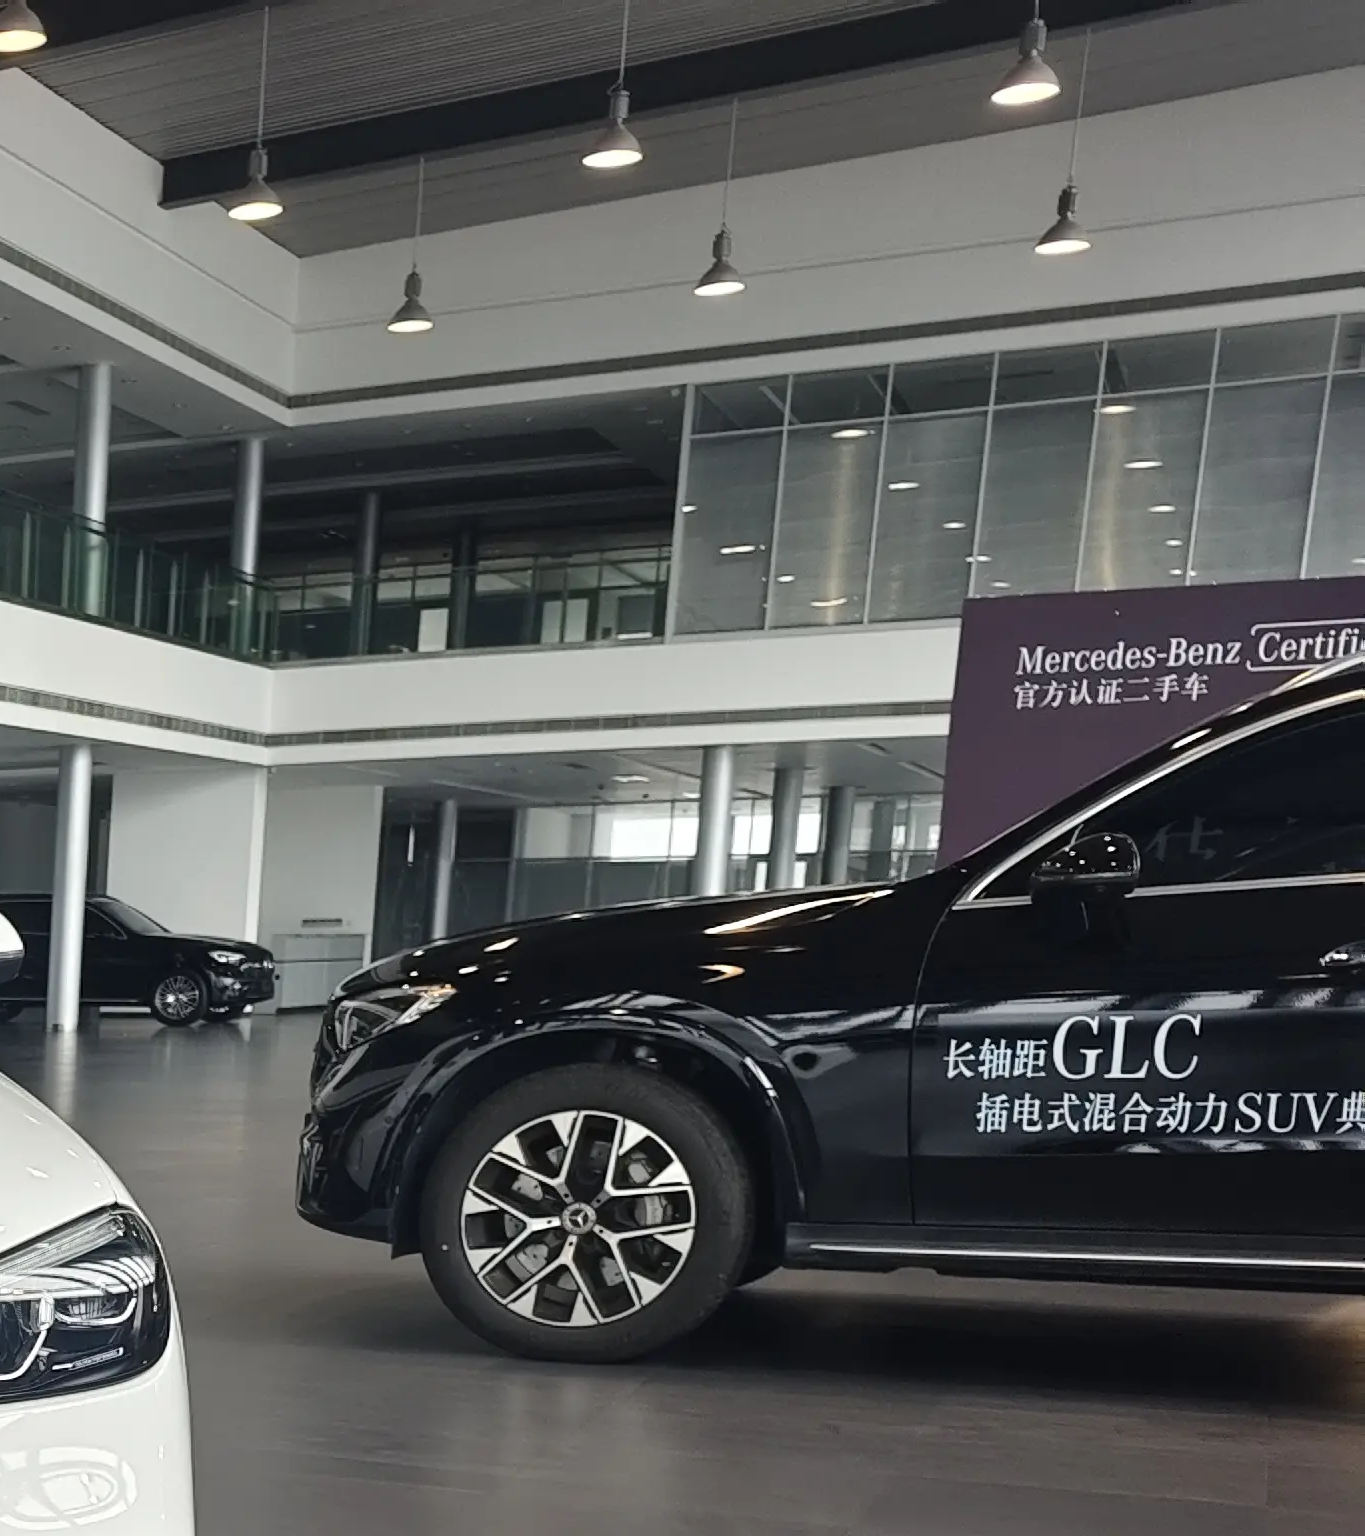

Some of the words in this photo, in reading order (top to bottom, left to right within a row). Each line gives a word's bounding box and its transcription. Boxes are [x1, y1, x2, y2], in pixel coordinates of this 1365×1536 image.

[1015, 636, 1242, 676] Mercedes-Benz
[1257, 627, 1365, 663] Certifi
[1013, 671, 1210, 711] 官方认证二手车
